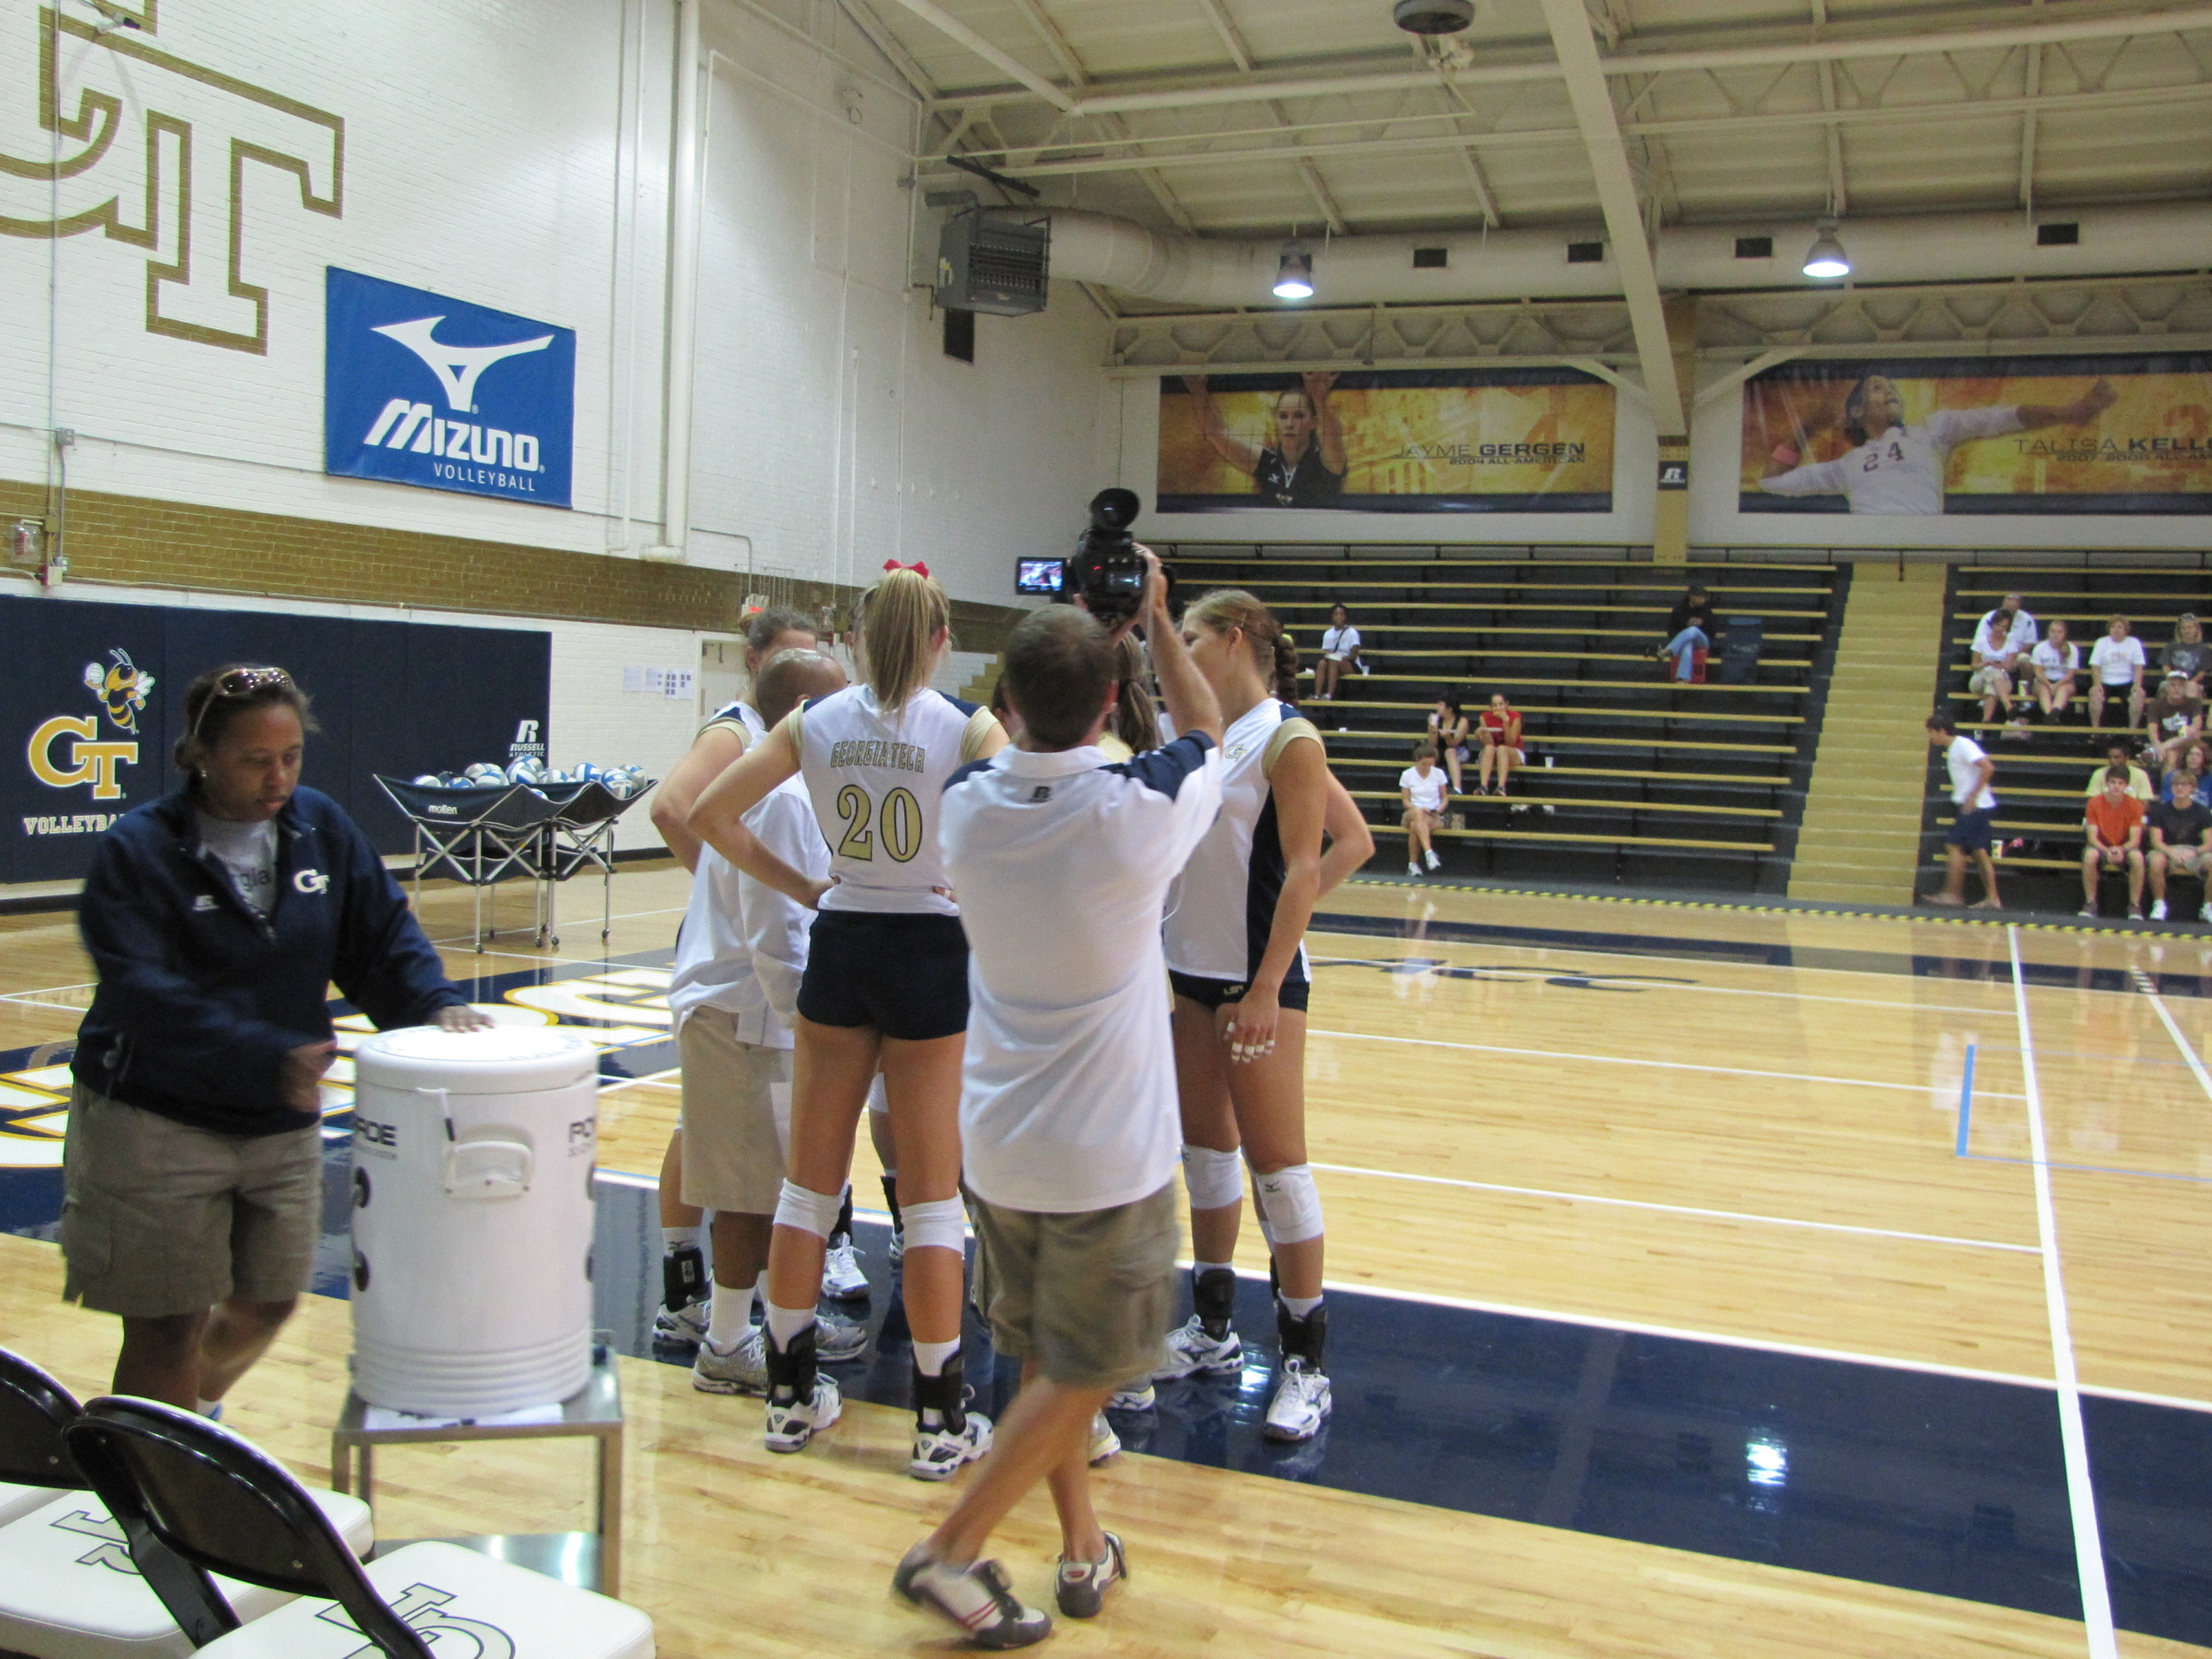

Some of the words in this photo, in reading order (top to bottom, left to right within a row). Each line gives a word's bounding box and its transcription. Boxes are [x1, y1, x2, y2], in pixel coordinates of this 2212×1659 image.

[364, 398, 539, 472] MIZUNO
[2014, 439, 2117, 452] TALISA
[1394, 444, 1471, 457] JAYME
[1479, 442, 1585, 457] GERGEN
[434, 462, 535, 491] VOLLEYBALL
[28, 715, 139, 800] GT
[830, 741, 887, 768] GEORGIA
[890, 742, 926, 772] TECH
[428, 804, 457, 814] molten
[836, 783, 923, 863] 20
[24, 813, 126, 835] VOLLEYBA
[293, 868, 331, 895] GT
